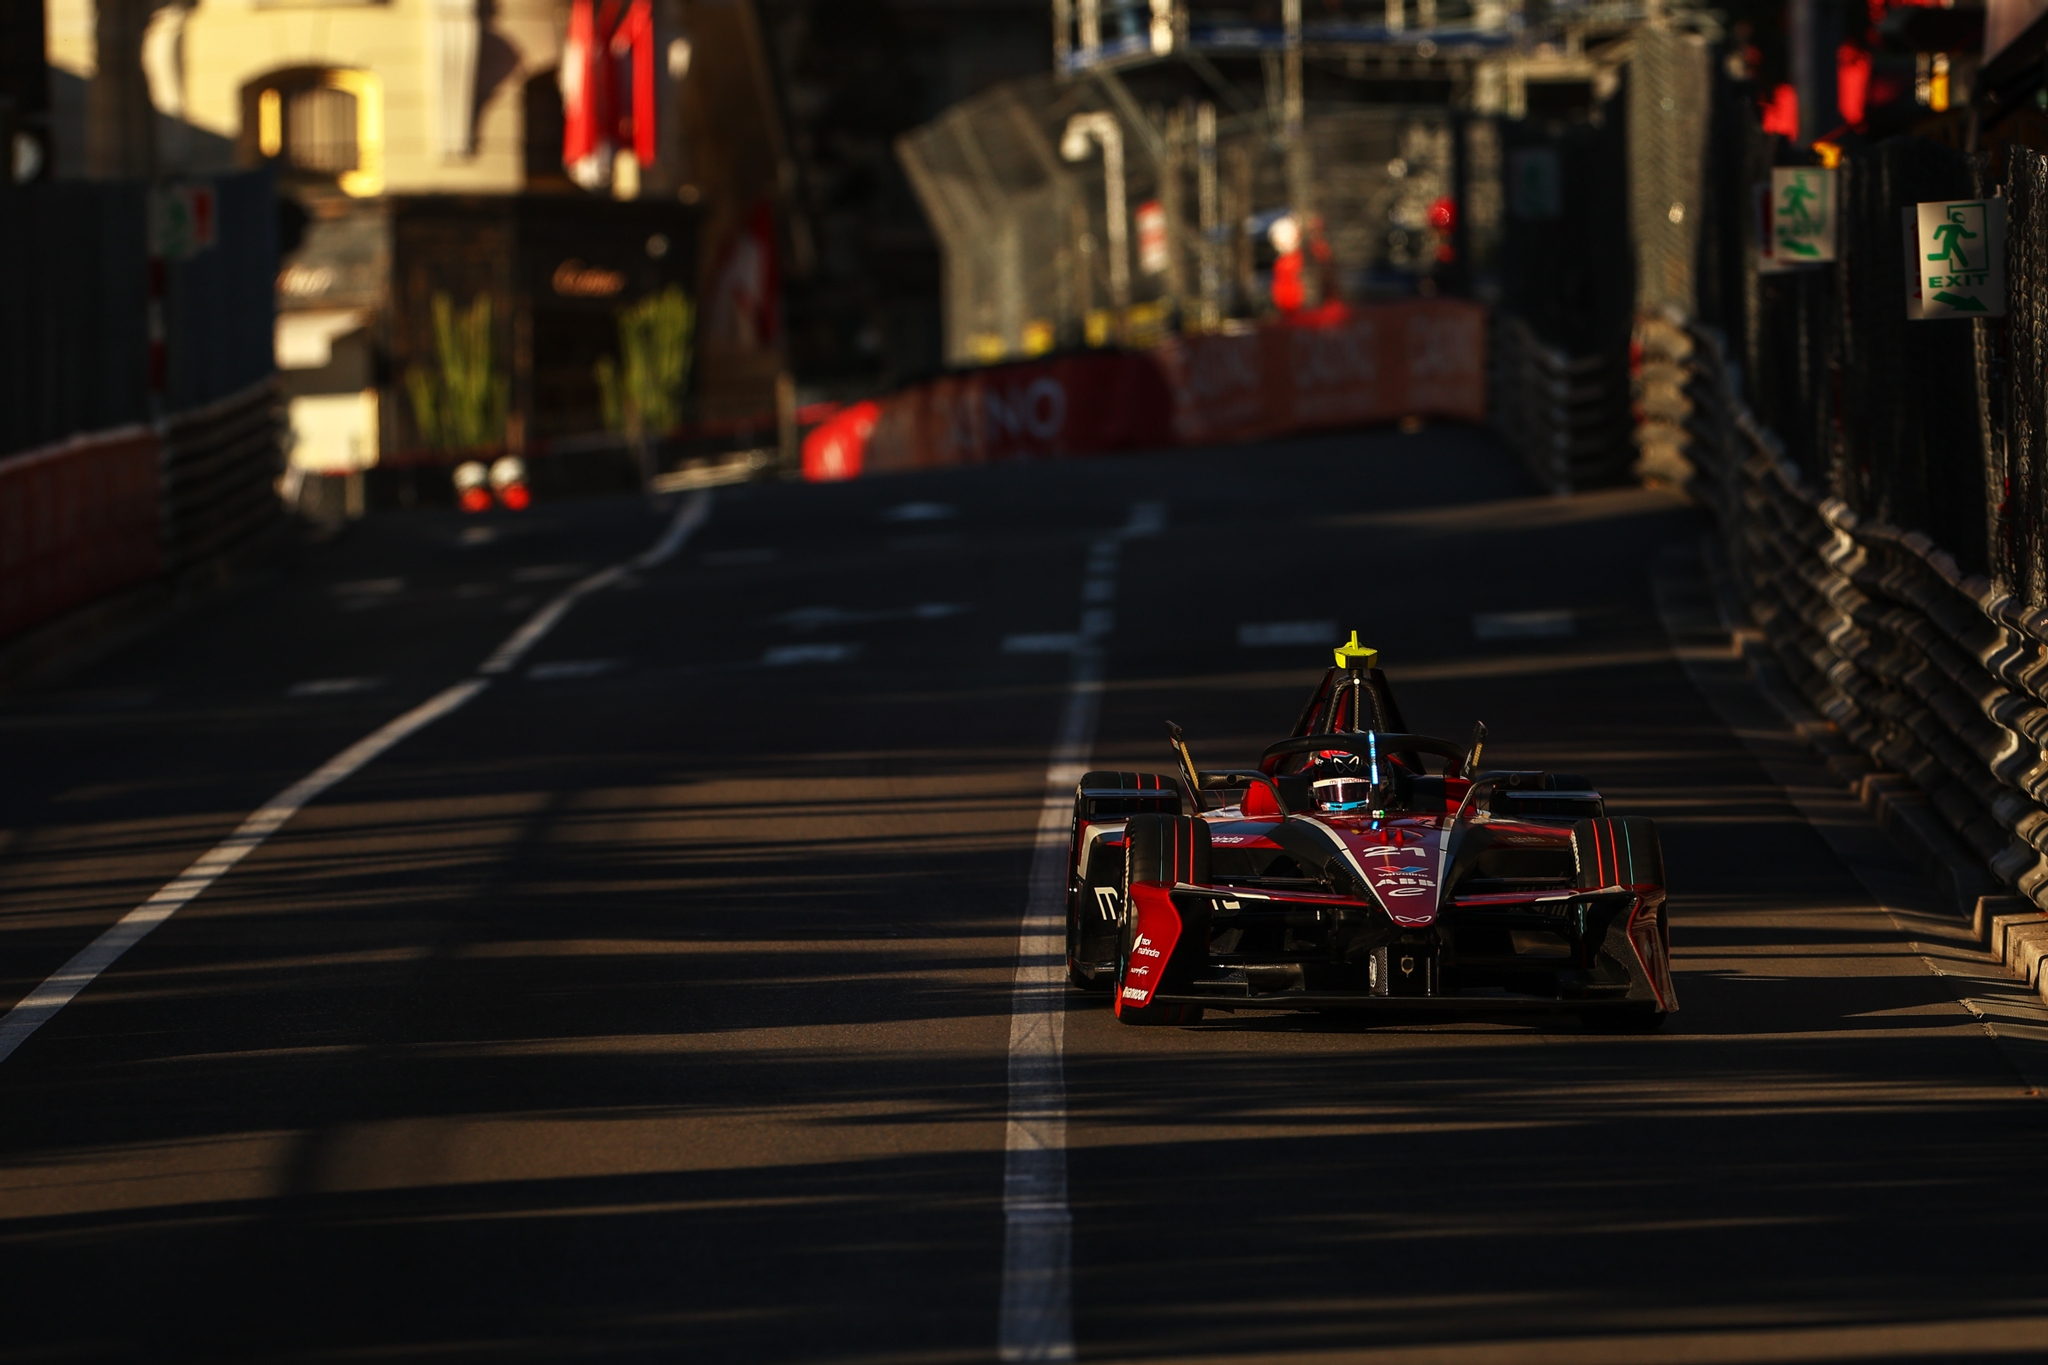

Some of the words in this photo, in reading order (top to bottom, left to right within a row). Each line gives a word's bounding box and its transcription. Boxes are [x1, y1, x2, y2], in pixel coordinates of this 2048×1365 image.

[1928, 273, 1989, 288] EXIT
[1363, 845, 1426, 858] 21
[1375, 878, 1437, 887] ABB
